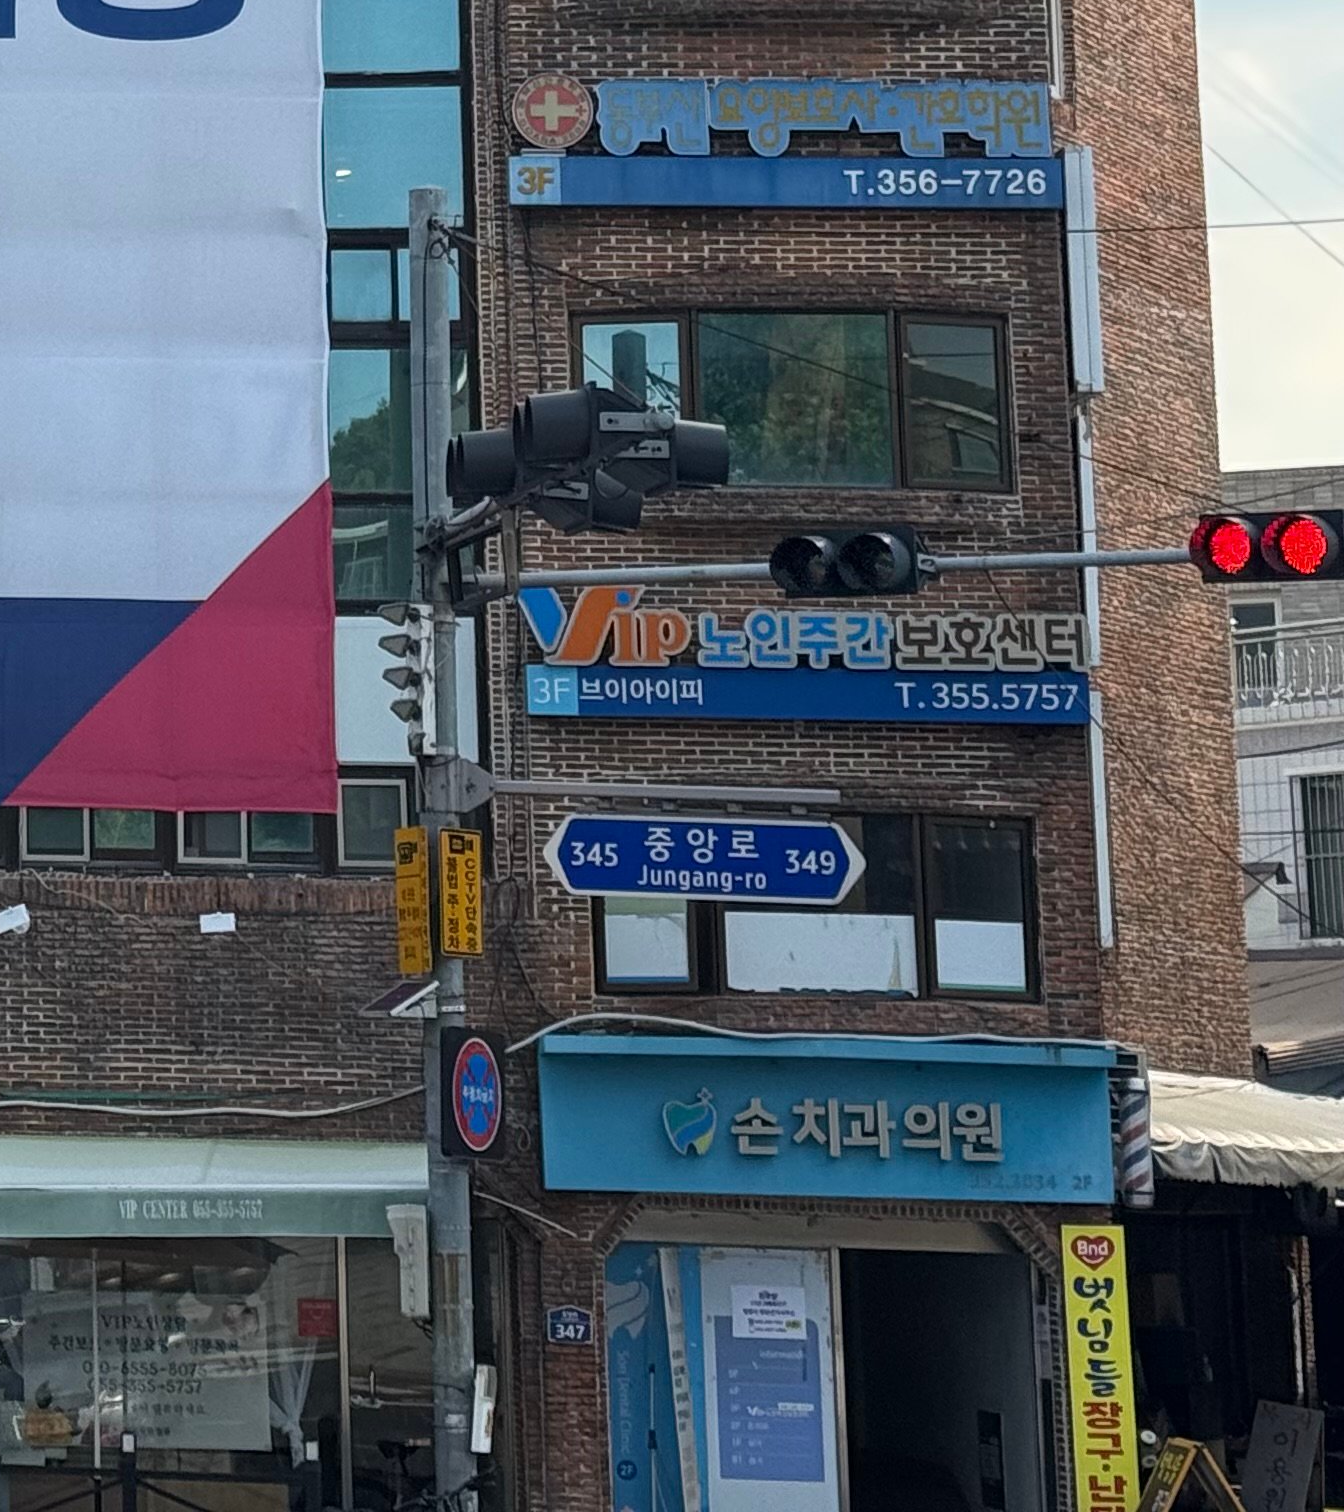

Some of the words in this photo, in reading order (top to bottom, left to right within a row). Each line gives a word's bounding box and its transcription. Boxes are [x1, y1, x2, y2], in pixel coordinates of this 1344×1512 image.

[516, 168, 555, 196] 3F
[843, 167, 1048, 197] T.356-7726
[532, 679, 571, 705] 3F
[579, 677, 705, 707] 브이아이피
[569, 842, 620, 868] 345
[643, 826, 761, 862] 중앙로
[784, 848, 837, 877] 349
[637, 864, 768, 892] Jungang-ro
[119, 1199, 139, 1220] VIP
[142, 1199, 189, 1221] CENTER
[1076, 1239, 1109, 1256] Bnd
[554, 1324, 586, 1340] 347
[82, 1360, 208, 1378] 00-6555-8075
